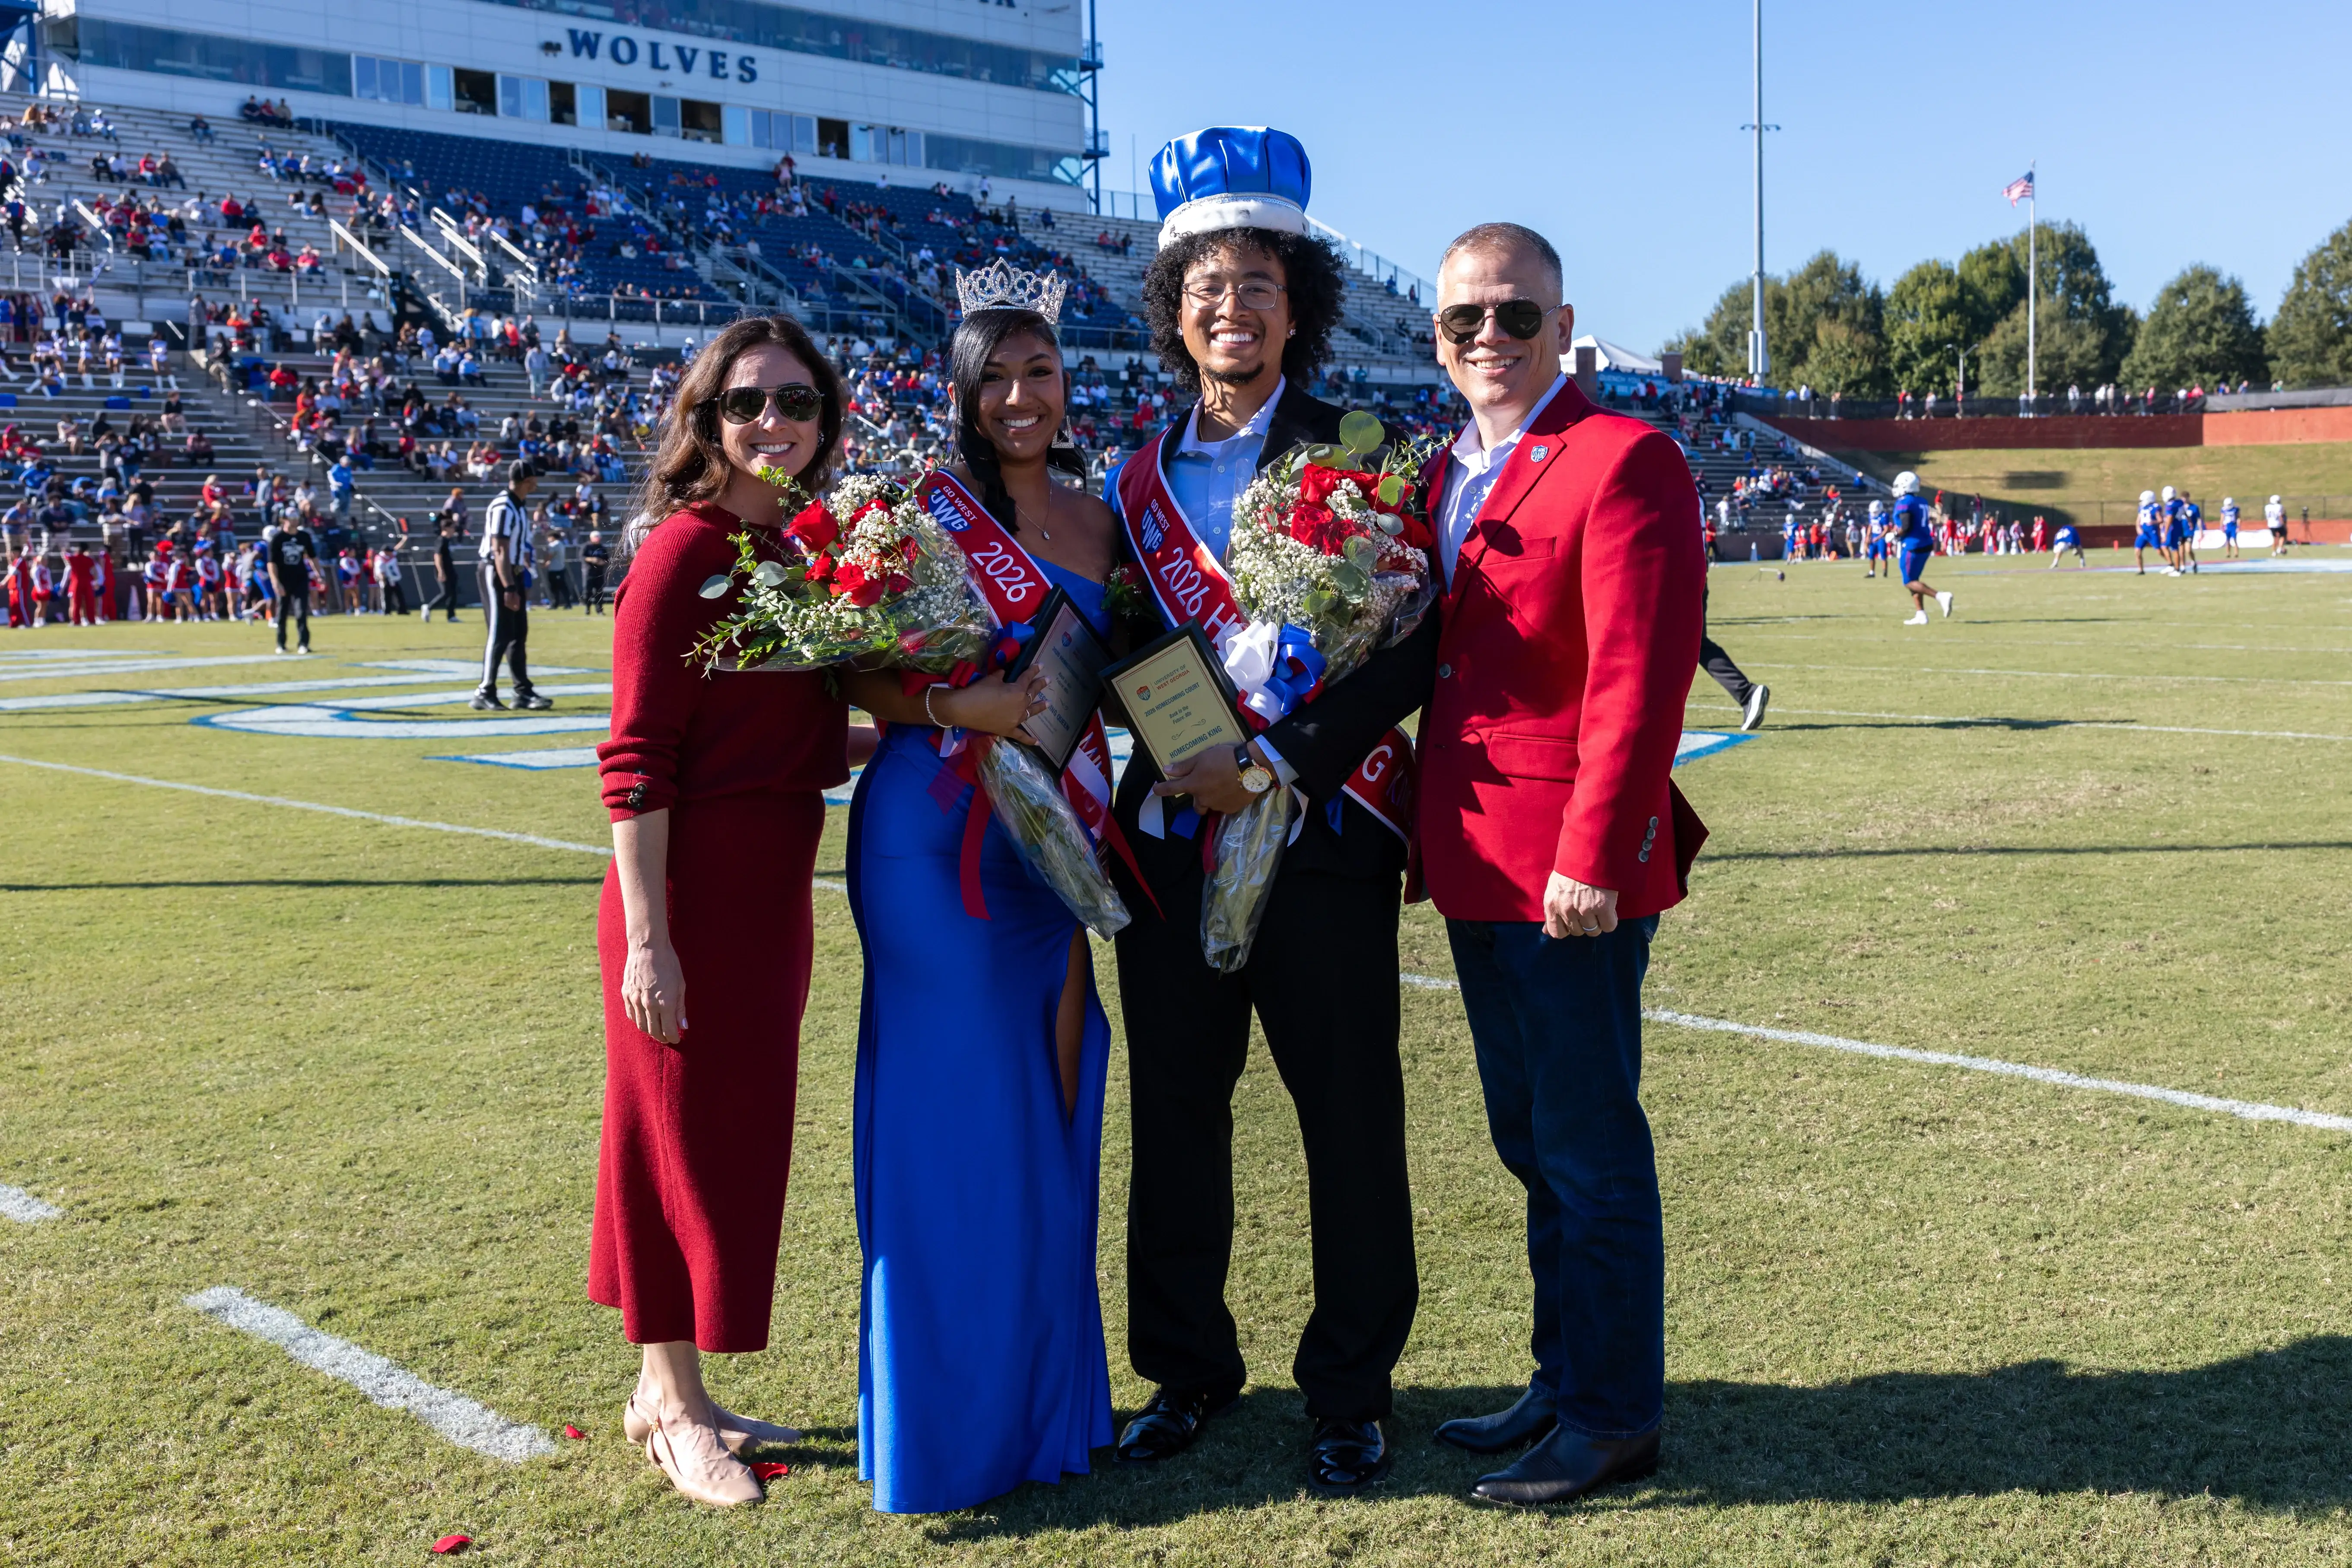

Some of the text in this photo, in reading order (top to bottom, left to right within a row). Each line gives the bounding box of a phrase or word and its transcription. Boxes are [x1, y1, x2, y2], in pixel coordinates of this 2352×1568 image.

[567, 35, 757, 84] WOLVES
[931, 489, 968, 530] UWG
[943, 486, 978, 521] GO WEST
[1151, 499, 1170, 532] GO WEST
[1142, 509, 1162, 550] UWG
[971, 541, 1036, 602] 2026
[1159, 547, 1210, 617] 2026
[1154, 668, 1179, 685] UNIVERSITY
[1157, 669, 1190, 690] WEST GEORGIA
[1155, 690, 1186, 711] HOMECOMING
[1186, 682, 1200, 693] COURT
[1057, 713, 1070, 731] QUEEN
[1169, 710, 1178, 719] Back
[1173, 716, 1185, 724] Future:
[1170, 725, 1223, 759] HOMECOMING KING
